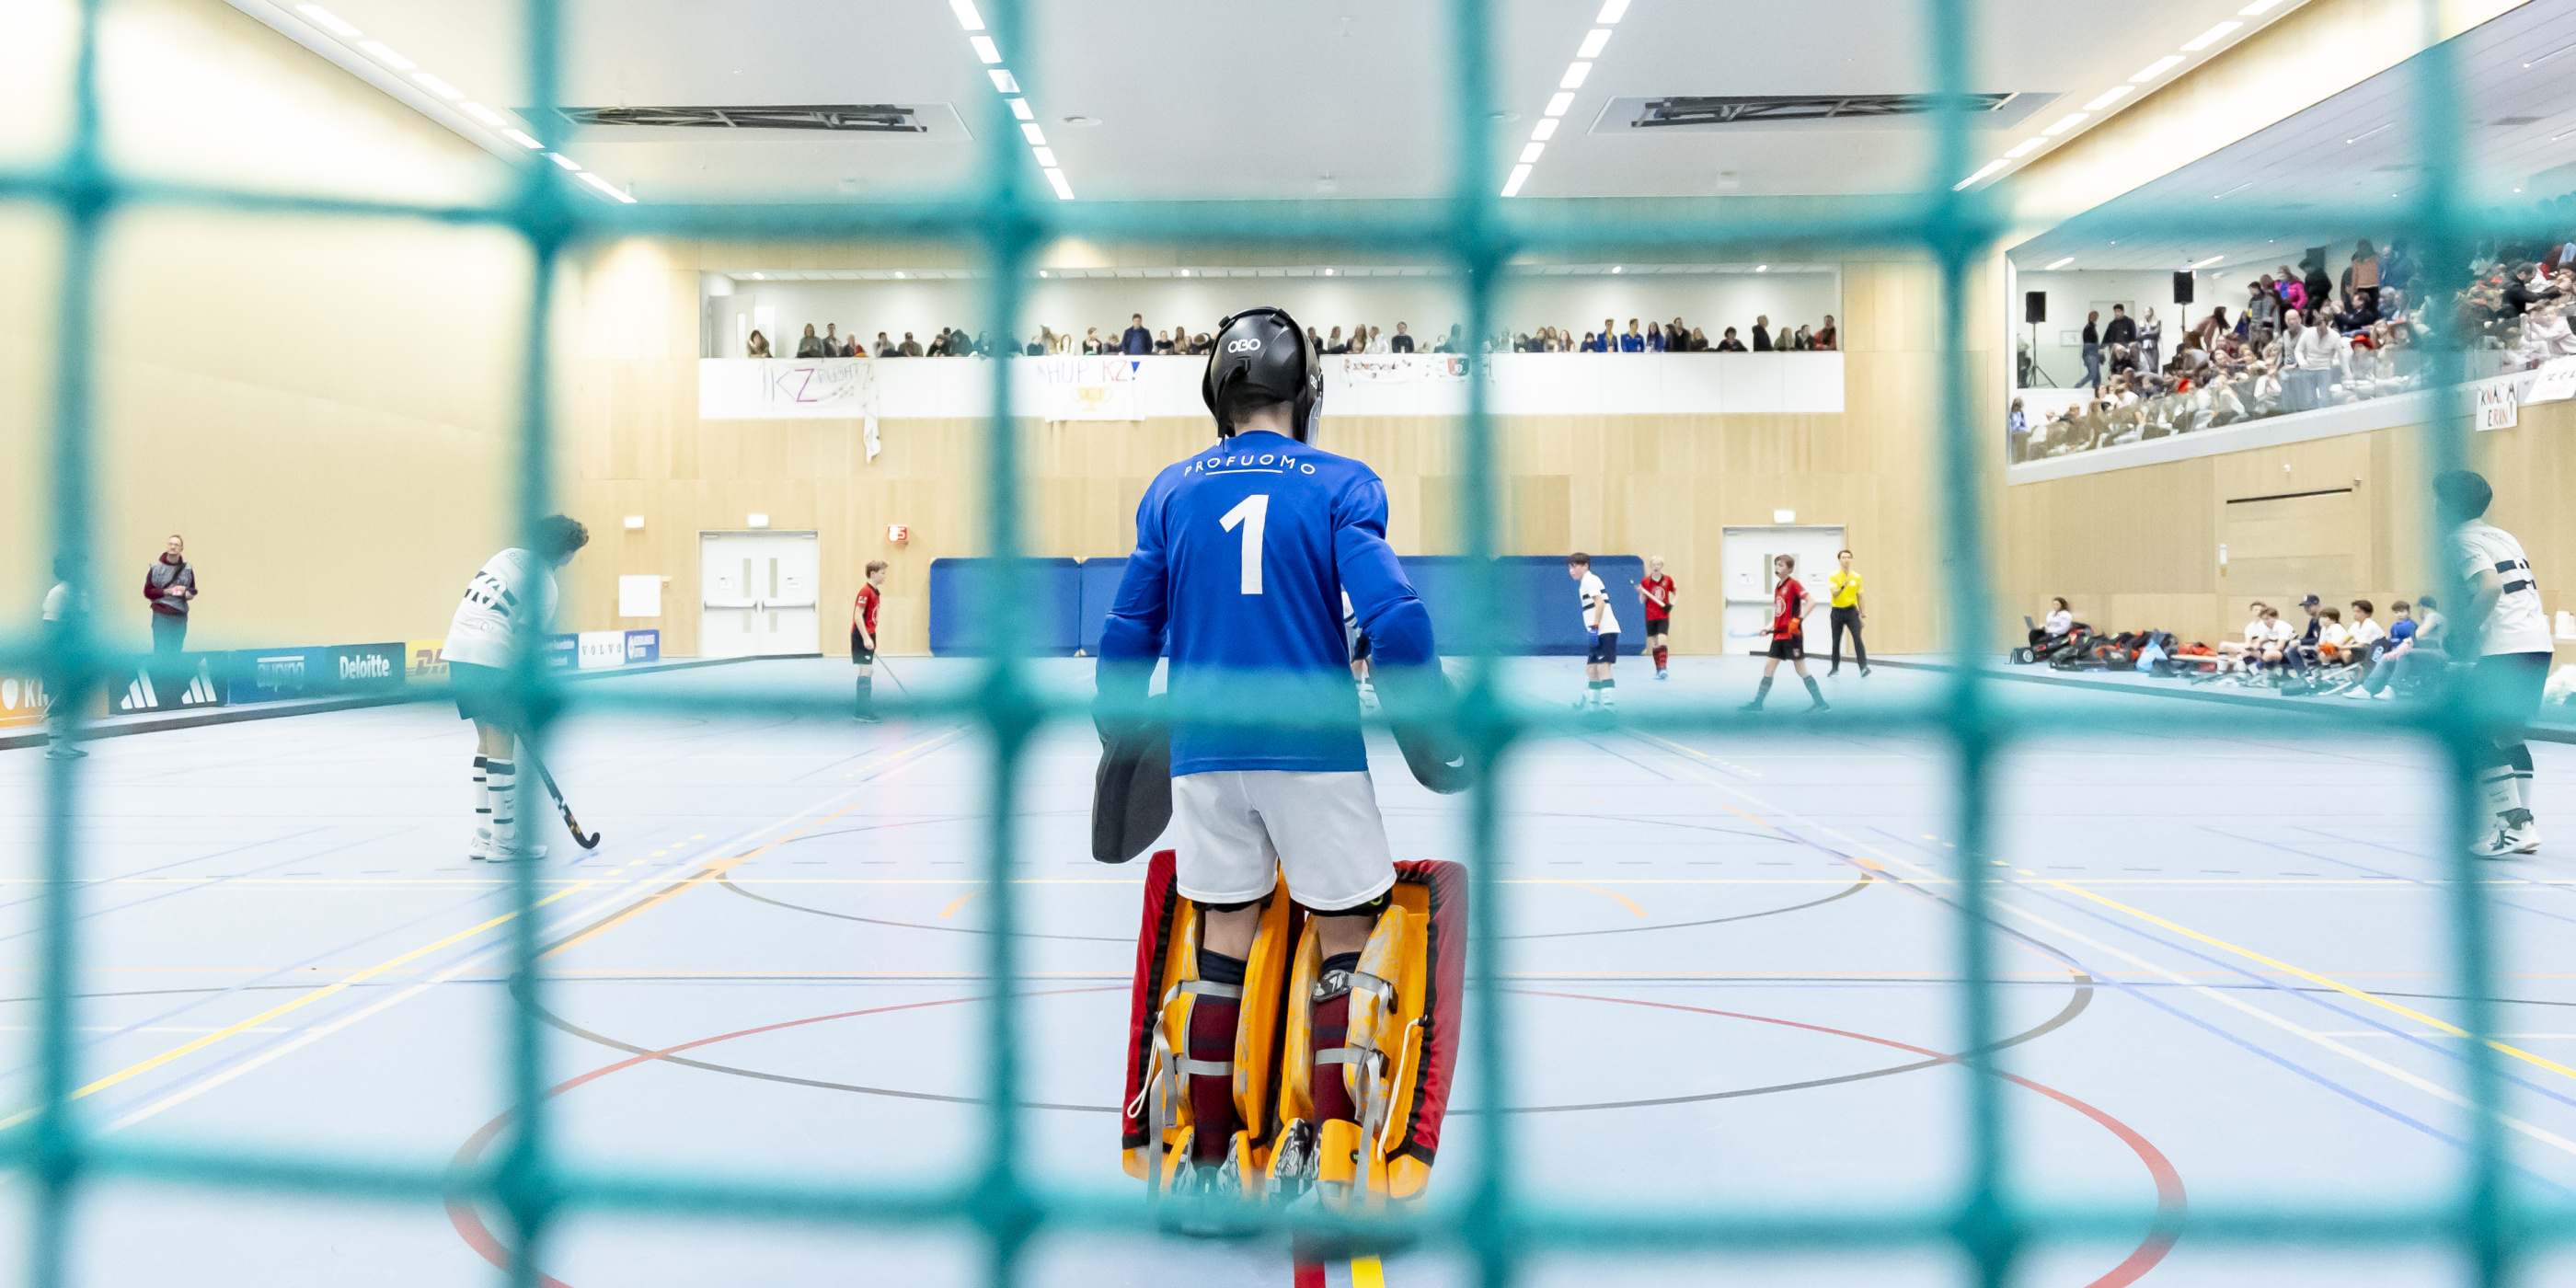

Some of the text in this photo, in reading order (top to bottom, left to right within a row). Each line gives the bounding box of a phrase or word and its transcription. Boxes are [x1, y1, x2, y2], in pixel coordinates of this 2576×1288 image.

[1228, 339, 1261, 353] OBO
[1047, 359, 1088, 385] HUP
[1183, 454, 1316, 477] PROFUOMO
[1219, 494, 1270, 594] 1
[415, 648, 449, 676] DH
[581, 643, 622, 655] VOLVO
[339, 654, 390, 680] Deloitte
